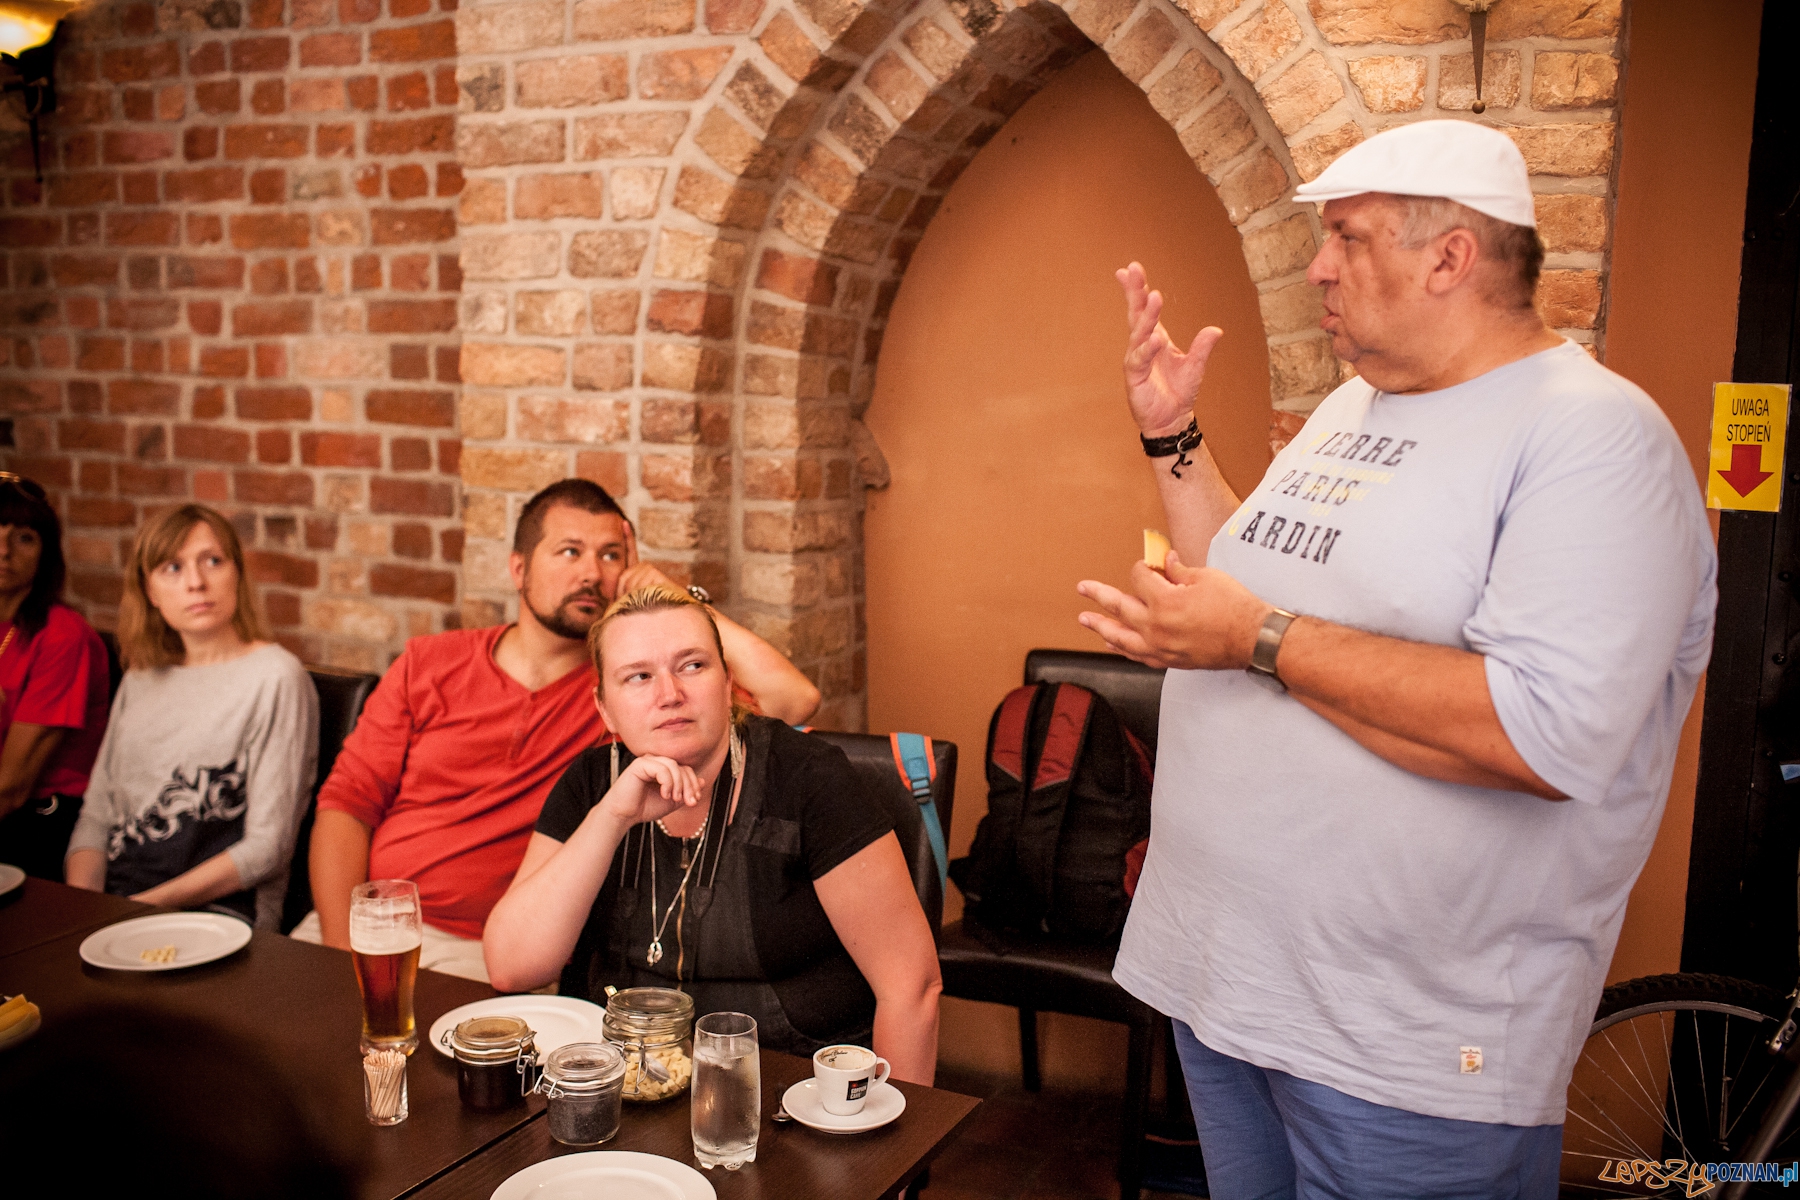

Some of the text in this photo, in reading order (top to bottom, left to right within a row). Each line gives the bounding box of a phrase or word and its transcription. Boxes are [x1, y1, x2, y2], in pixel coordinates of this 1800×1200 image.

[1732, 399, 1770, 416] UWAGA
[1302, 431, 1418, 467] PIERRE
[1727, 421, 1771, 442] STOPIEŃ
[1271, 469, 1360, 506] PARIS
[1228, 506, 1343, 564] CARDIN
